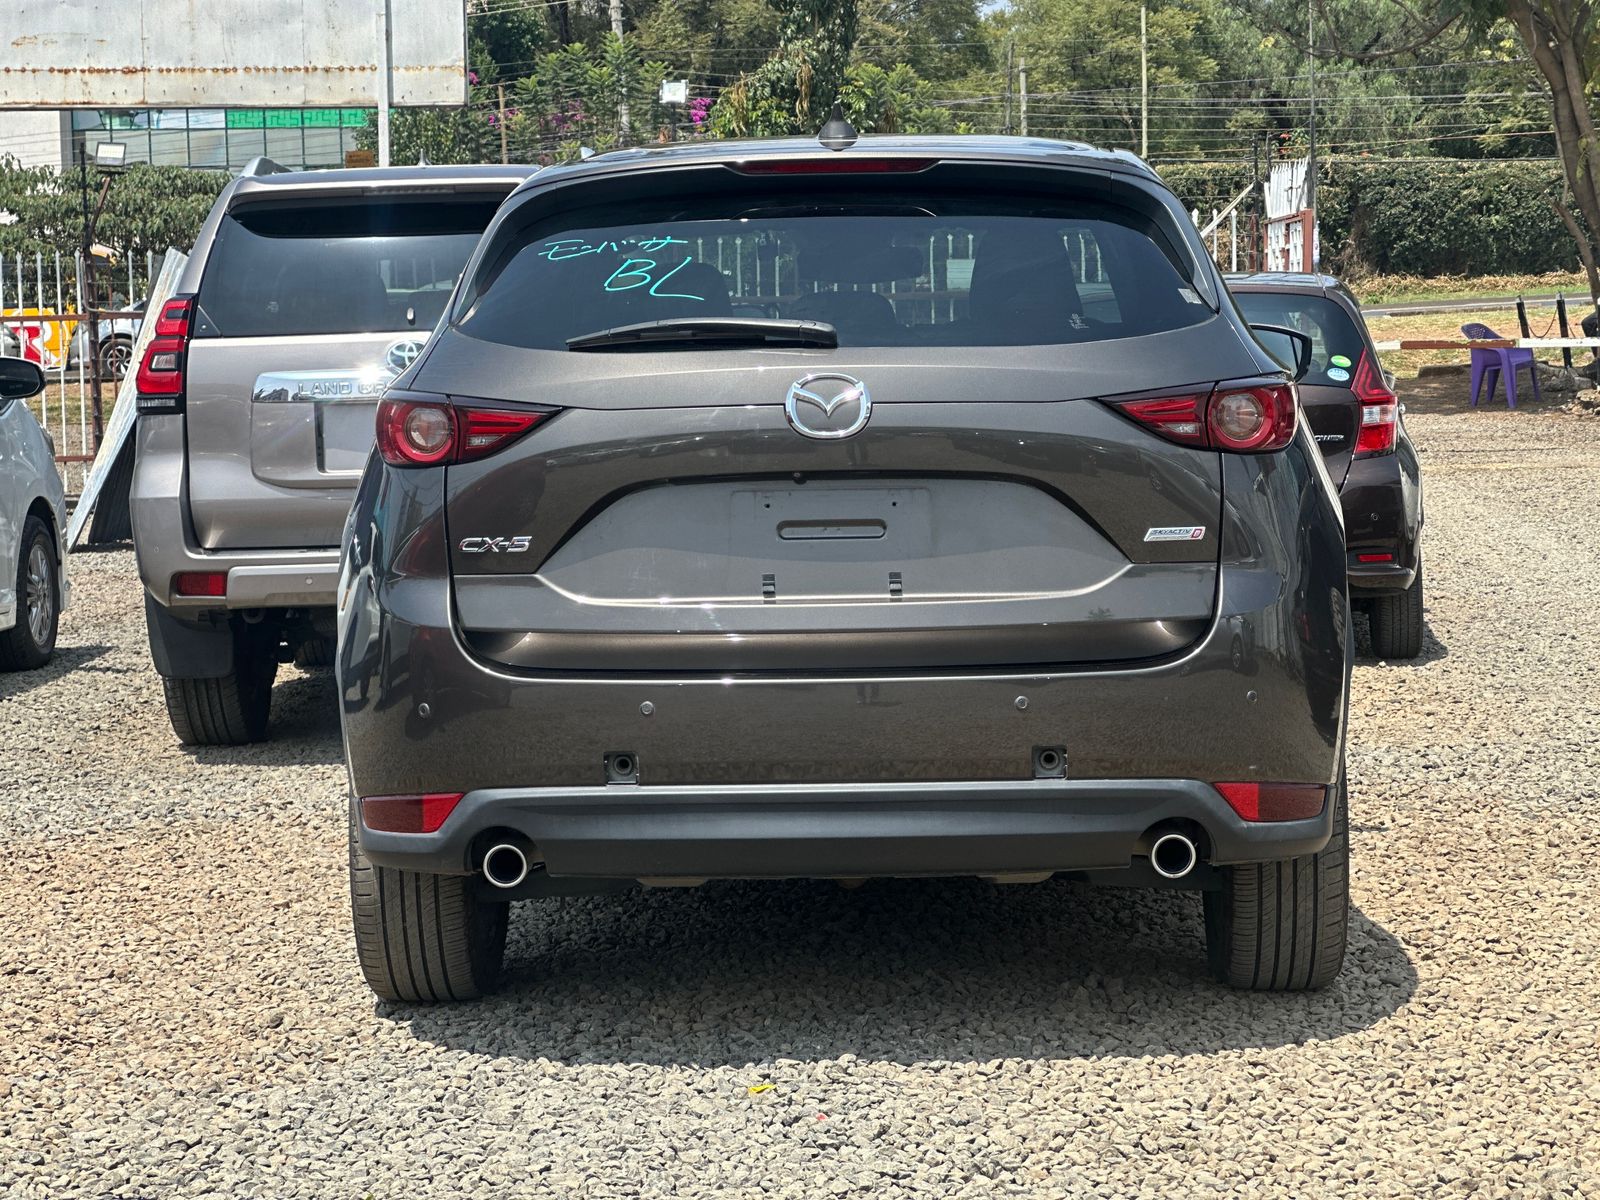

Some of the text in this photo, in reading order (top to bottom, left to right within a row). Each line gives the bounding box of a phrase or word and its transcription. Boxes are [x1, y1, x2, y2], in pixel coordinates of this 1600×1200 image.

[298, 381, 353, 396] LAND
[1151, 528, 1192, 536] SKYACTIV
[459, 535, 533, 553] CX-5
